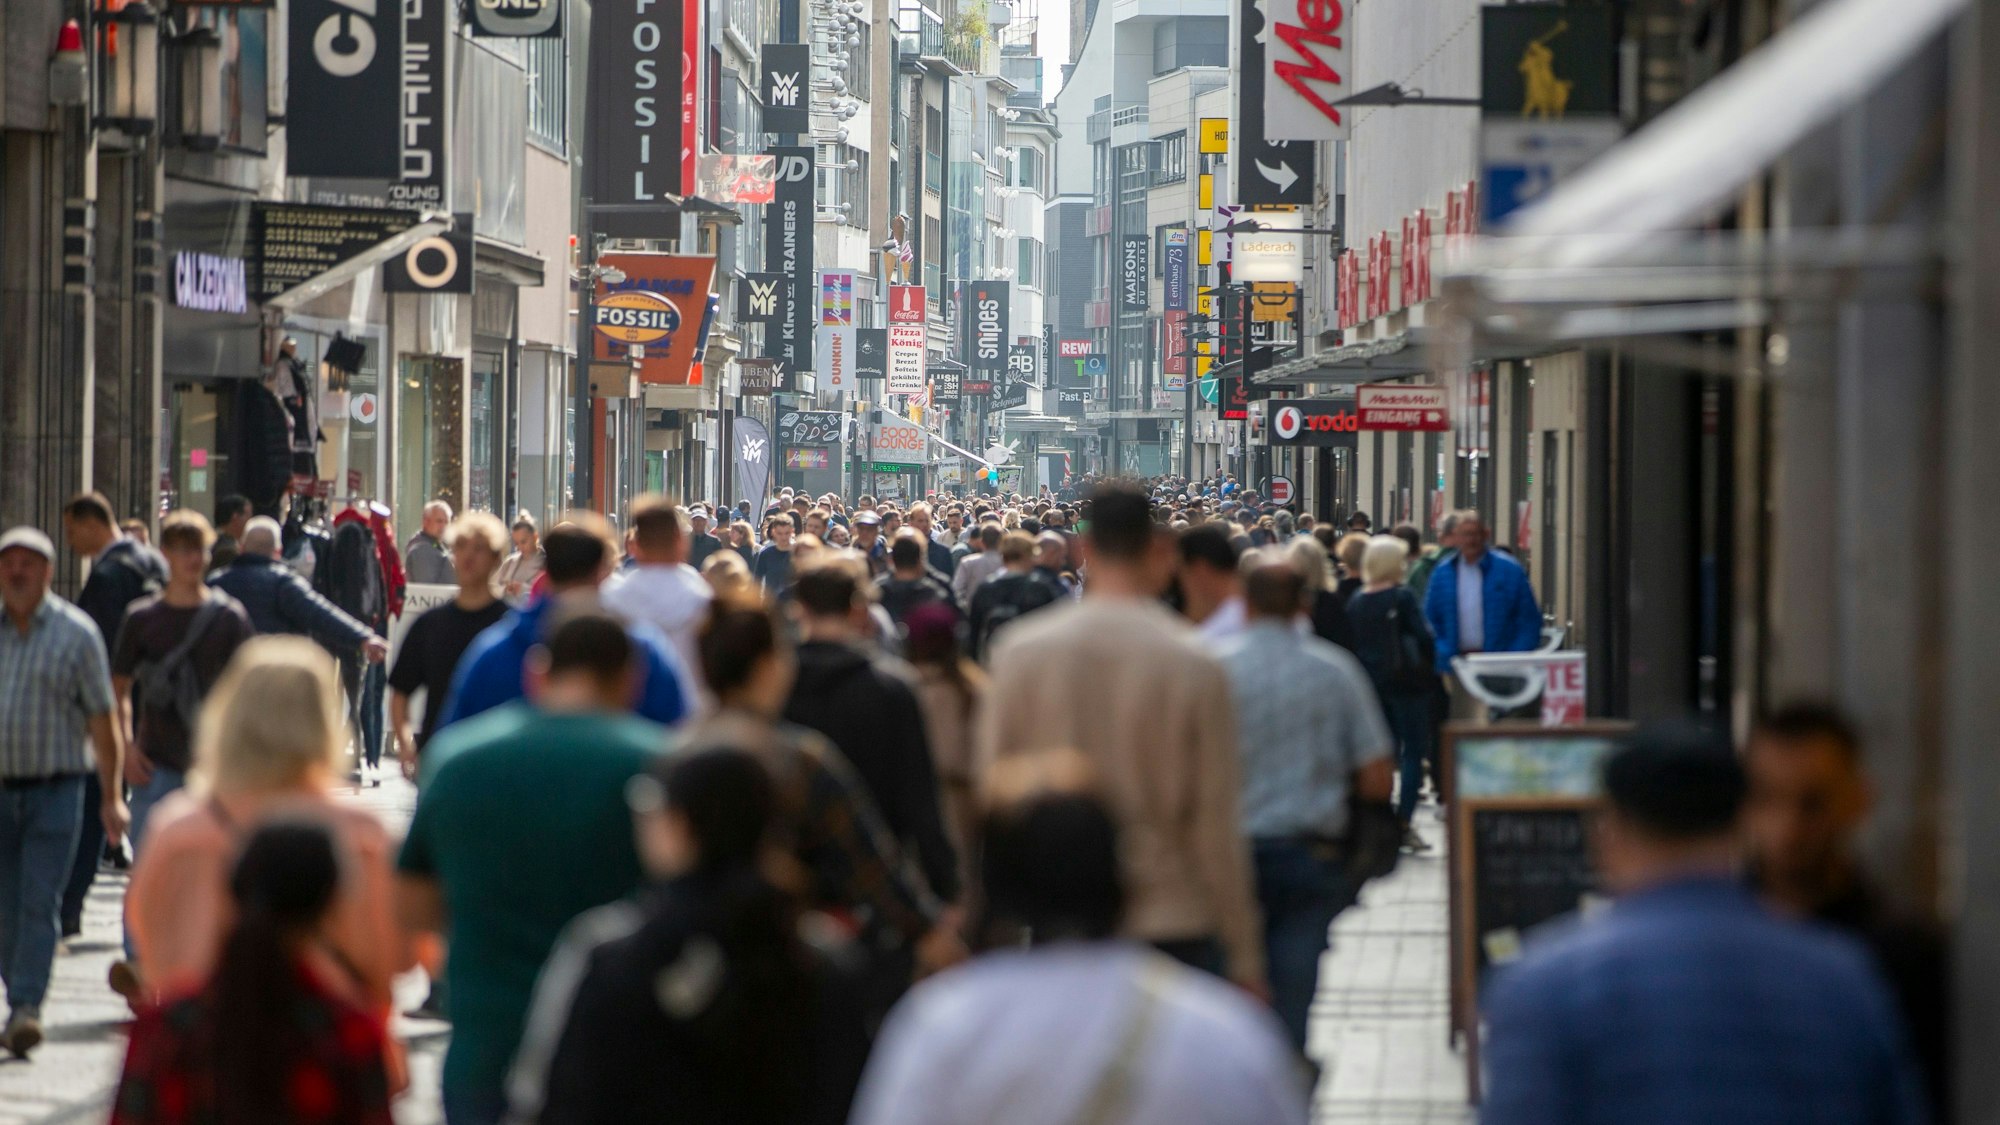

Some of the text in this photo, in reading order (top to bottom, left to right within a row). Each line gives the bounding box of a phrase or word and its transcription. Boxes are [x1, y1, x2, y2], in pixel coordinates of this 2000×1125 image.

[771, 71, 800, 106] WMF
[389, 184, 440, 200] OUNG
[1168, 248, 1183, 263] 73
[1125, 241, 1137, 304] MAISONS
[748, 279, 778, 315] WMF
[1140, 291, 1146, 304] DU
[597, 307, 671, 329] FOSSIL
[893, 328, 921, 337] Pizza
[978, 300, 1003, 359] snipes
[891, 338, 923, 348] König
[831, 333, 842, 385] DUNKIN'
[1169, 376, 1182, 384] dm
[1059, 391, 1081, 402] Fast.
[1365, 410, 1421, 425] EINGANG
[881, 427, 919, 440] FOOD
[873, 437, 924, 450] LOUNGE
